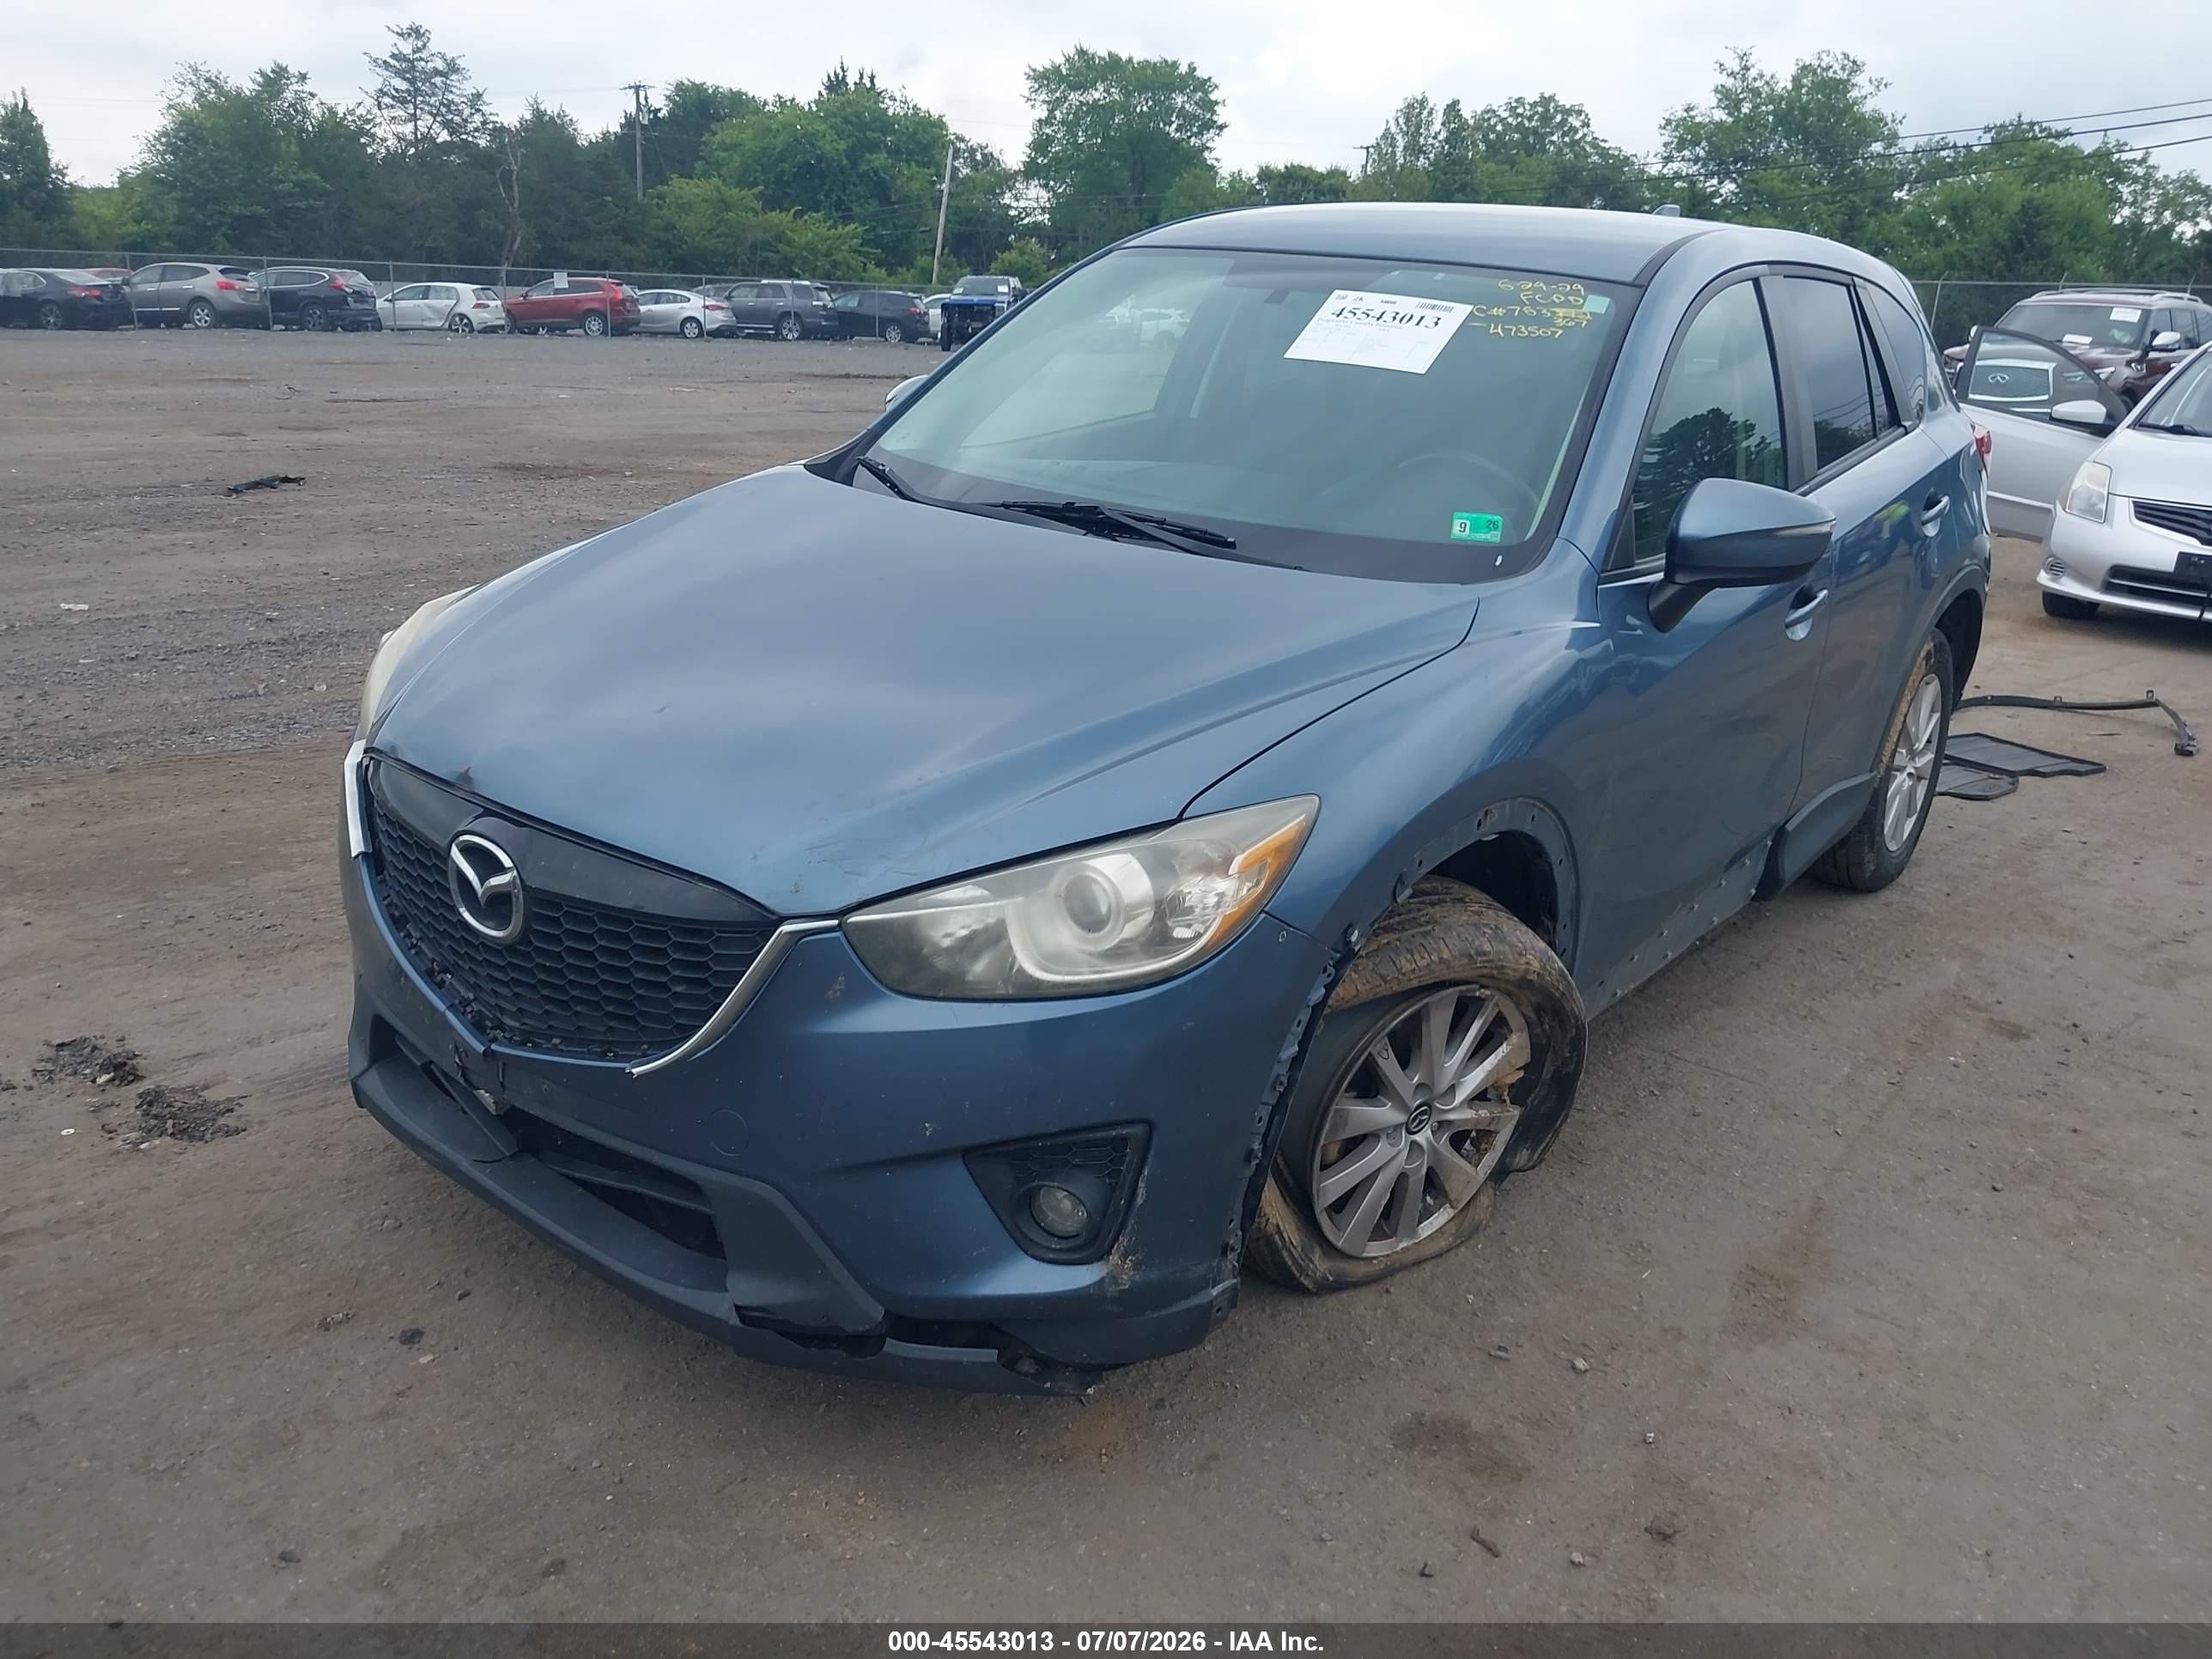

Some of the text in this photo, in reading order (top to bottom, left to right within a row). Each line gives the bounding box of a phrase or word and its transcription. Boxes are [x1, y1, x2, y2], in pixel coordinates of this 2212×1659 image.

[1331, 306, 1442, 328] 45543013
[1458, 520, 1499, 533] 9 26
